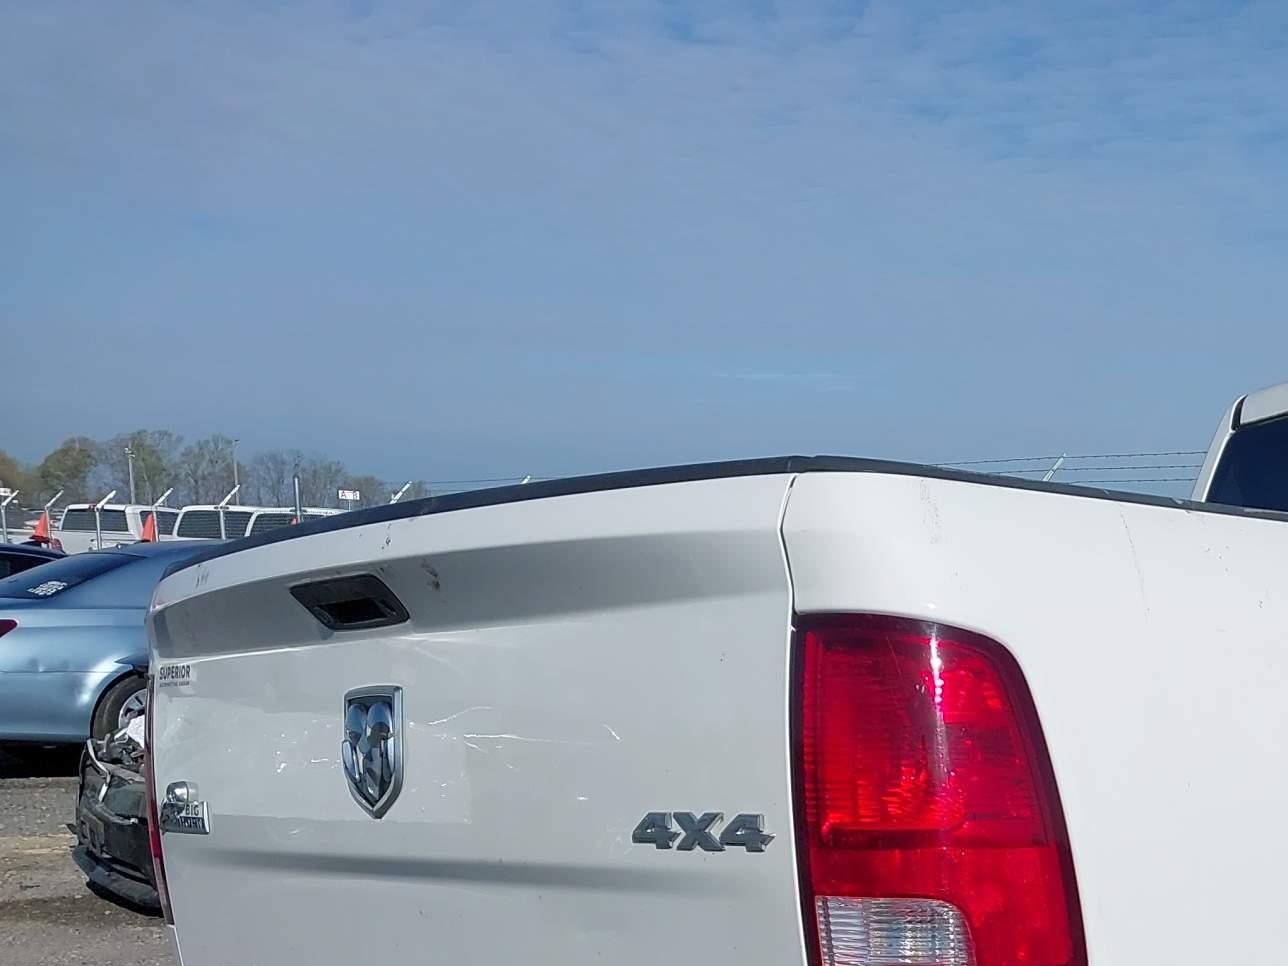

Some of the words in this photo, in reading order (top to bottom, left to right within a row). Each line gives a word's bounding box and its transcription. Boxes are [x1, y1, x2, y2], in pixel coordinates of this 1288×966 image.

[159, 665, 191, 680] SUPERIOR
[185, 804, 200, 817] BIG
[632, 812, 777, 853] 4X4
